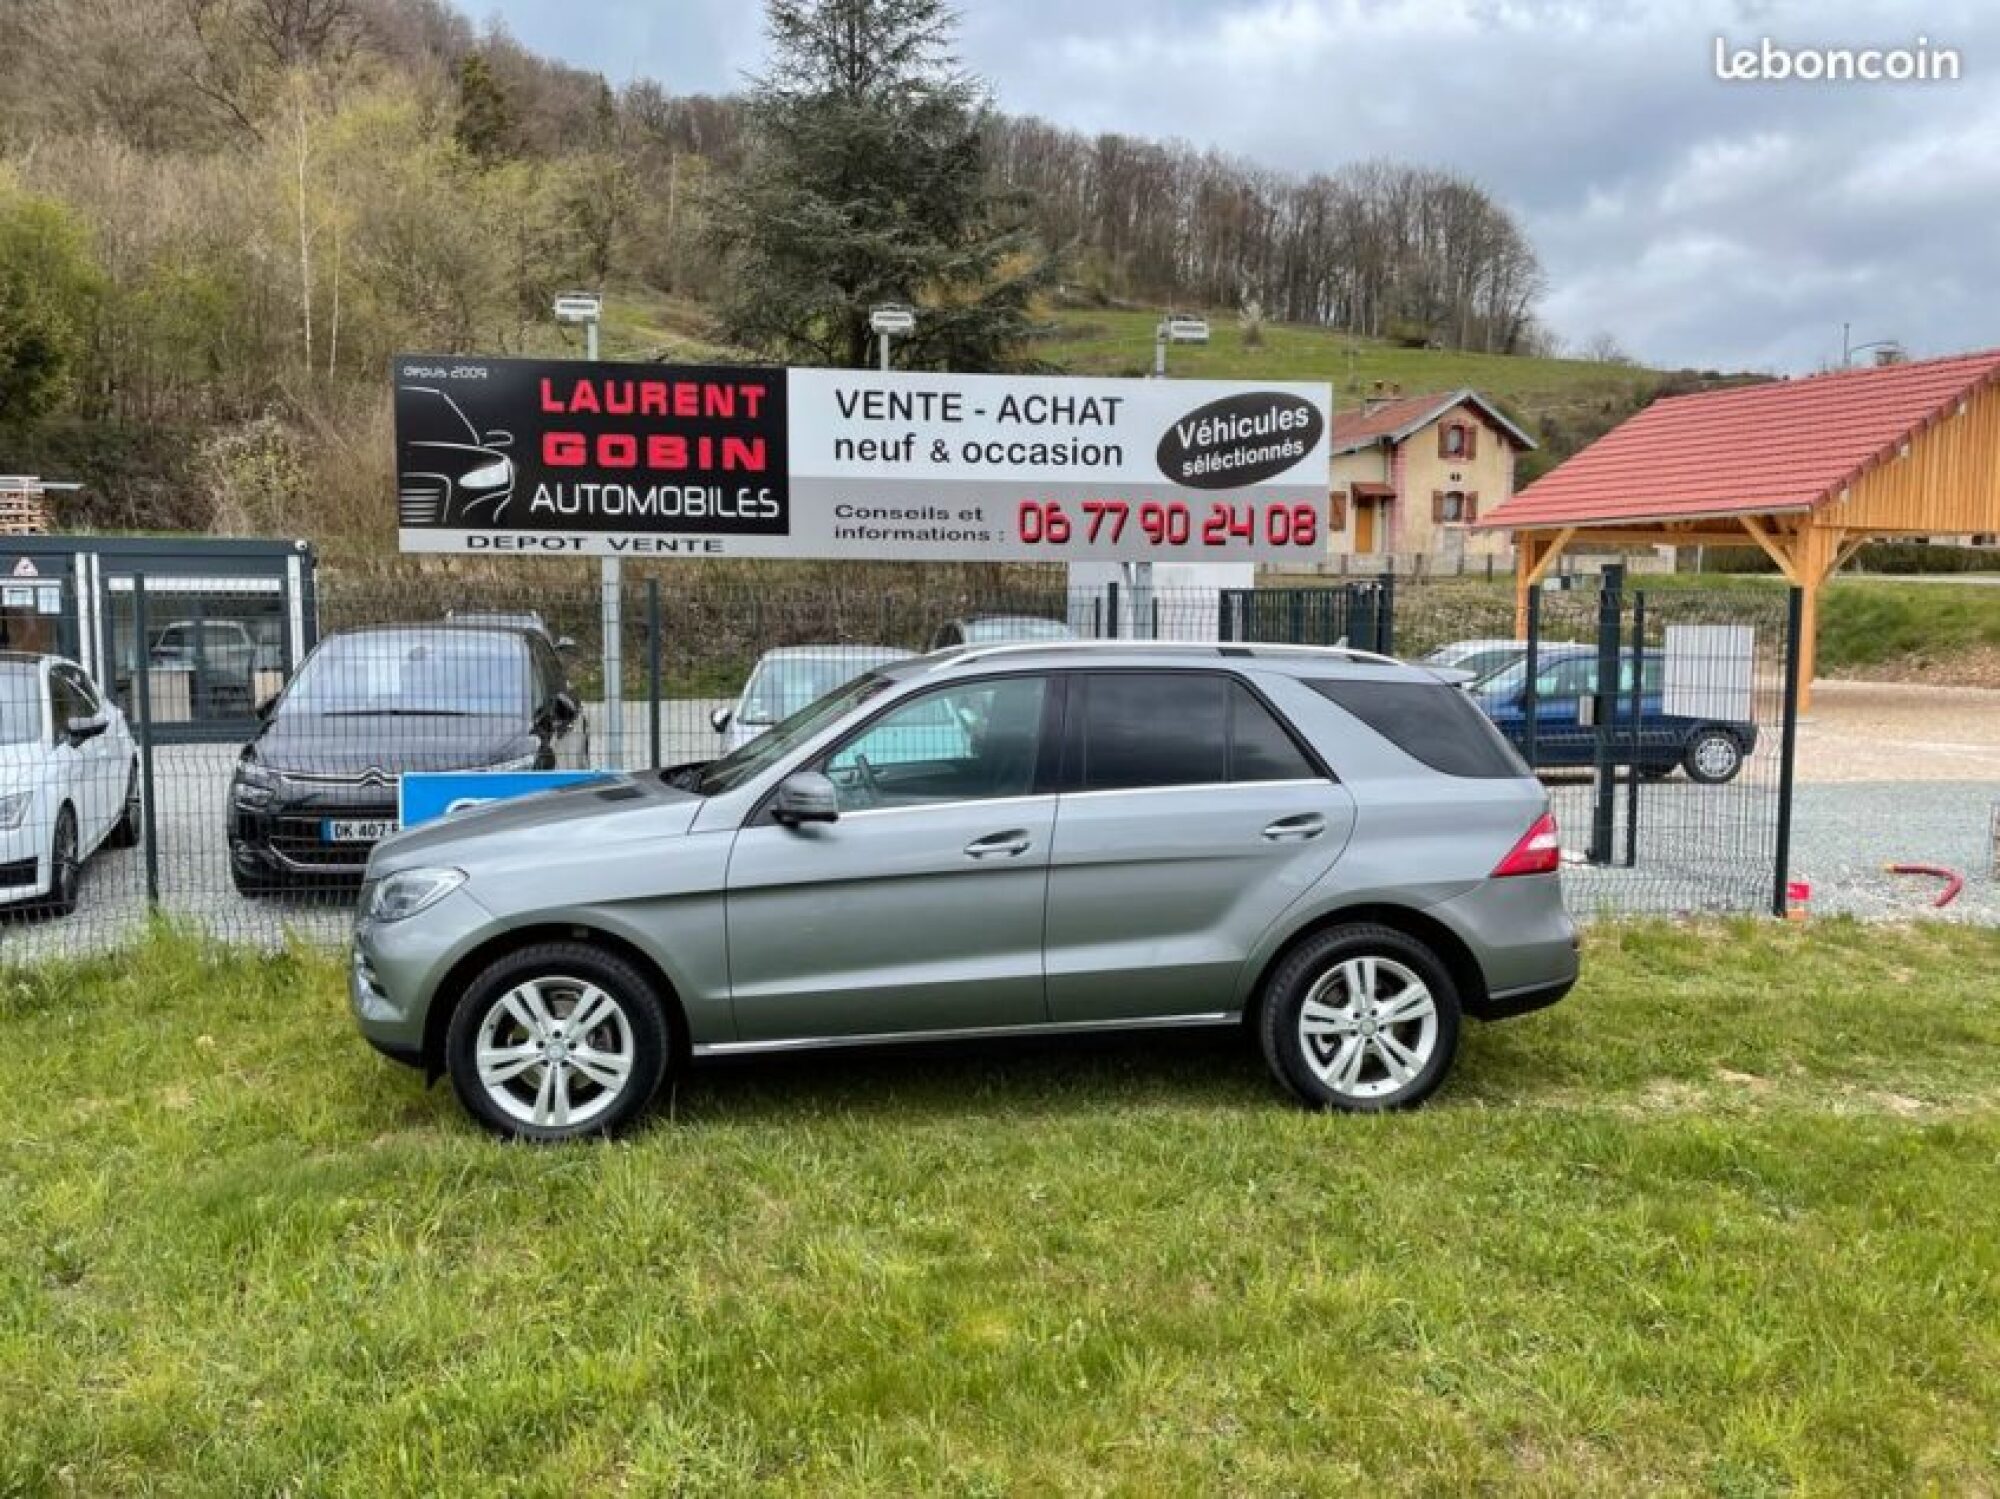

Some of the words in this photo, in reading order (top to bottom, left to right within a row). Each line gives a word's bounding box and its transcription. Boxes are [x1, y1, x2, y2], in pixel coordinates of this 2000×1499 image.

[450, 366, 487, 379] 2009
[541, 378, 766, 418] LAURENT
[835, 389, 963, 422] VENTE
[997, 394, 1124, 426] ACHAT
[1177, 405, 1309, 449] Véhicules
[542, 432, 766, 471] GOBIN
[834, 432, 916, 462] neuf
[929, 438, 951, 463] &
[962, 437, 1123, 466] occasion
[1182, 437, 1305, 477] séléctionnés
[529, 483, 780, 518] AUTOMOBILES
[835, 504, 950, 521] Conseils
[958, 507, 984, 522] et
[835, 525, 990, 542] informations
[1019, 500, 1071, 544] 06
[1081, 502, 1129, 545] 77
[1139, 502, 1190, 546] 90
[1203, 502, 1255, 546] 24
[1267, 503, 1317, 546] 08
[467, 535, 588, 551] DEPOT
[607, 537, 726, 553] VENTE
